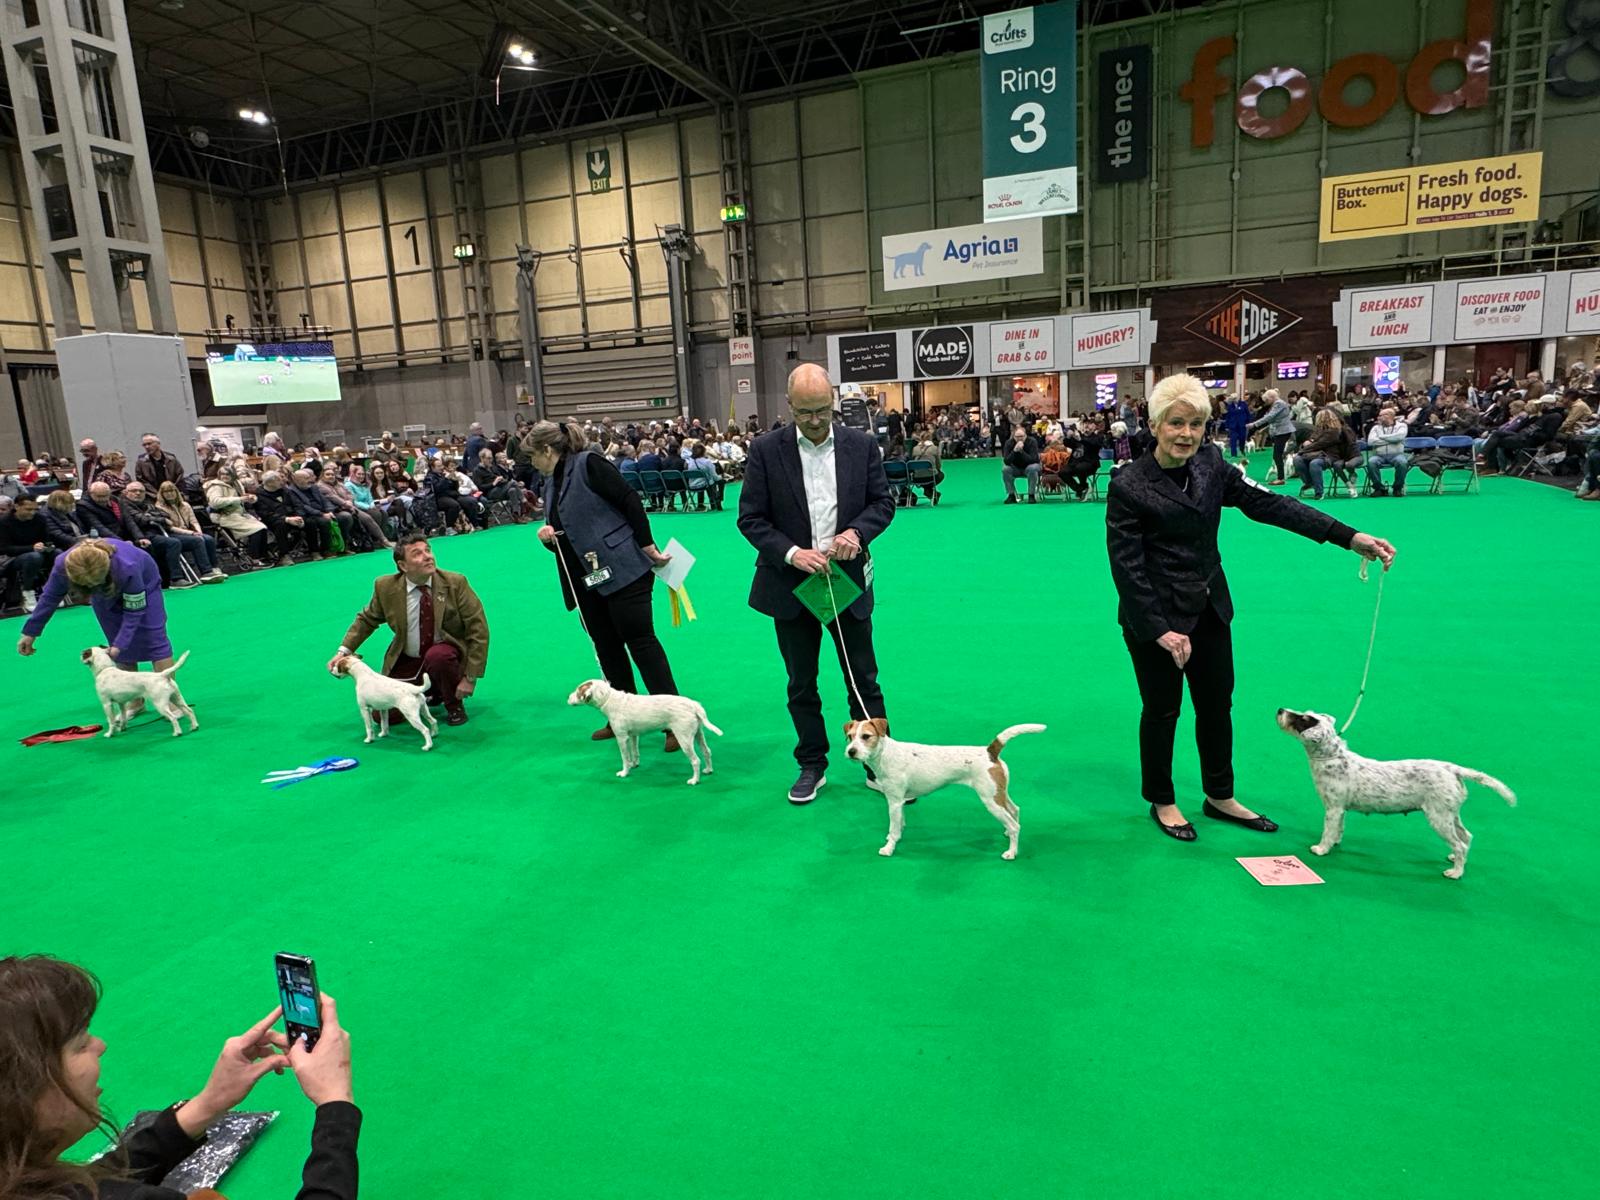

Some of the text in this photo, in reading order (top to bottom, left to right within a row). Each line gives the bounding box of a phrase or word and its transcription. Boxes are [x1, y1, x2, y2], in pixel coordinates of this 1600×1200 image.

[990, 28, 1027, 44] Crufts
[1001, 66, 1056, 94] Ring
[1180, 0, 1494, 148] food
[1107, 60, 1133, 168] the nec
[1010, 102, 1047, 154] 3
[592, 177, 609, 191] EXIT
[1418, 163, 1522, 190] Fresh food.
[1337, 181, 1405, 199] Butternut
[1416, 186, 1528, 211] Happy dogs.
[1337, 198, 1367, 210] Box.
[404, 226, 420, 265] 1
[943, 235, 1001, 263] Agria
[1359, 295, 1424, 313] BREAKFAST
[1460, 289, 1541, 306] DISCOVER FOOD
[1473, 306, 1488, 315] EAT
[1499, 304, 1526, 314] ENJOY
[1209, 299, 1278, 346] THE EDGE
[1370, 323, 1409, 337] LUNCH
[1005, 328, 1040, 341] DINE IN
[1077, 326, 1135, 352] HUNGRY?
[733, 342, 749, 350] Fire
[919, 341, 967, 357] MADE
[732, 352, 753, 362] point
[997, 350, 1047, 363] GRAB & GO
